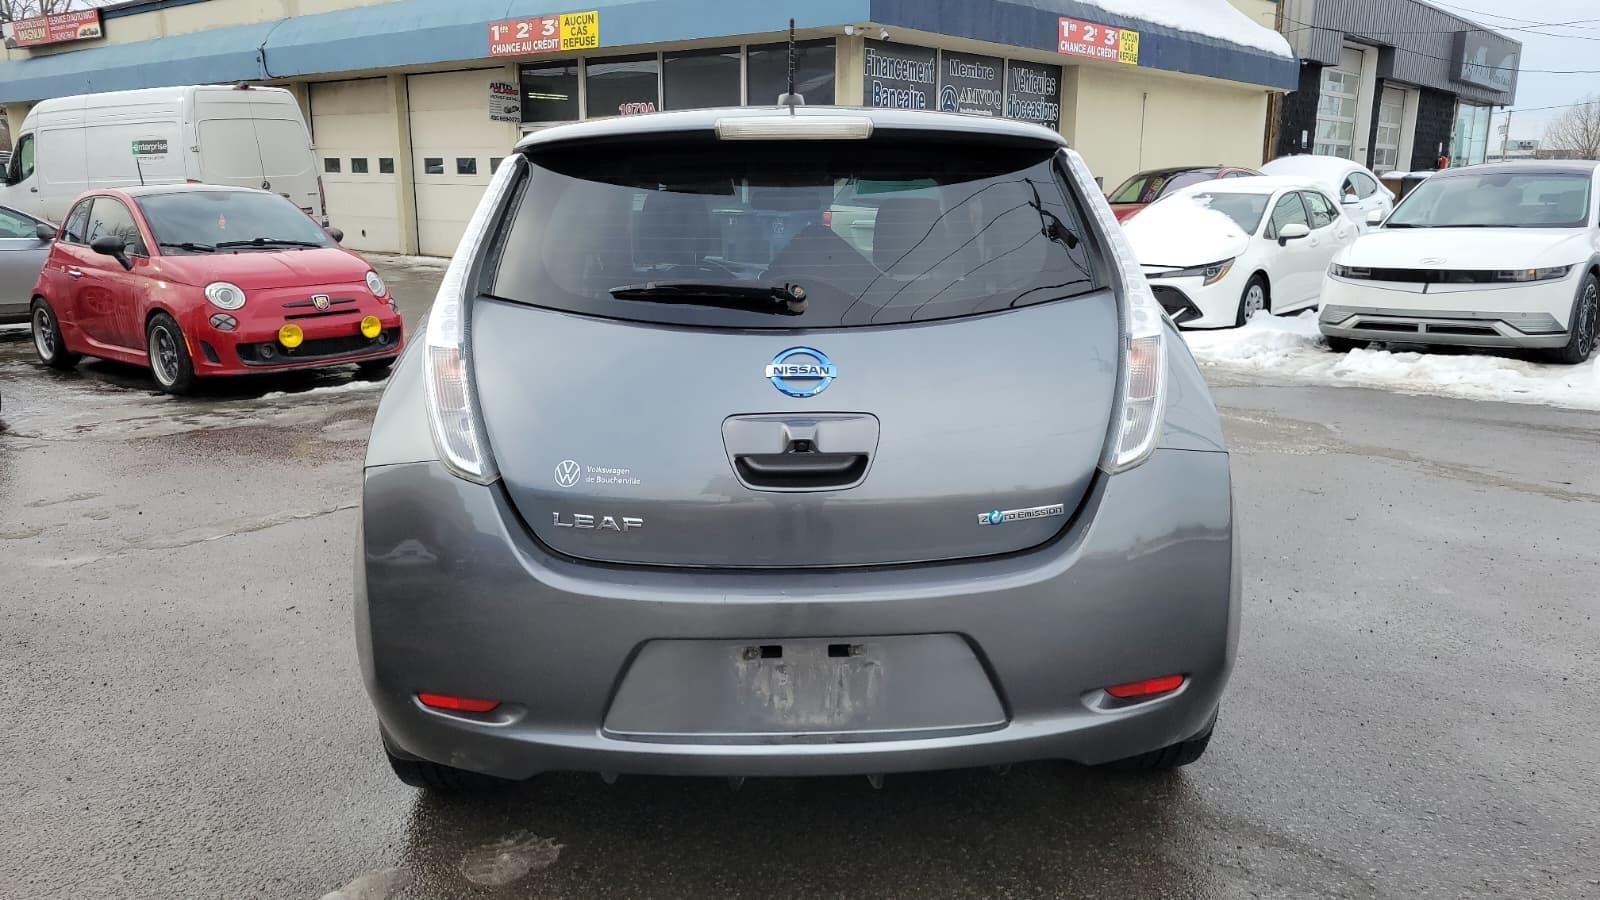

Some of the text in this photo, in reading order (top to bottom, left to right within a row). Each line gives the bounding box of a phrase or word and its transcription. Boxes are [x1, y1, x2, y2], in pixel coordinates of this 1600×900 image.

[564, 13, 595, 27] AUCUN
[570, 26, 588, 36] CAS
[492, 37, 559, 54] CHANCE AU CRÉDIT
[562, 33, 596, 48] REFUSÉ
[1060, 40, 1118, 58] CHANCE AU CRÉDIT
[864, 48, 935, 84] Financement
[950, 59, 994, 80] Membre
[1012, 68, 1056, 96] Véhicules
[873, 80, 926, 109] Bancaire
[1006, 94, 1058, 121] d'occasions
[132, 142, 168, 152] enterprise
[773, 366, 830, 376] NISSAN
[588, 465, 630, 476] Volkswagen
[596, 476, 640, 485] Boucherville
[1018, 506, 1062, 519] Emission
[552, 512, 644, 532] LEAF
